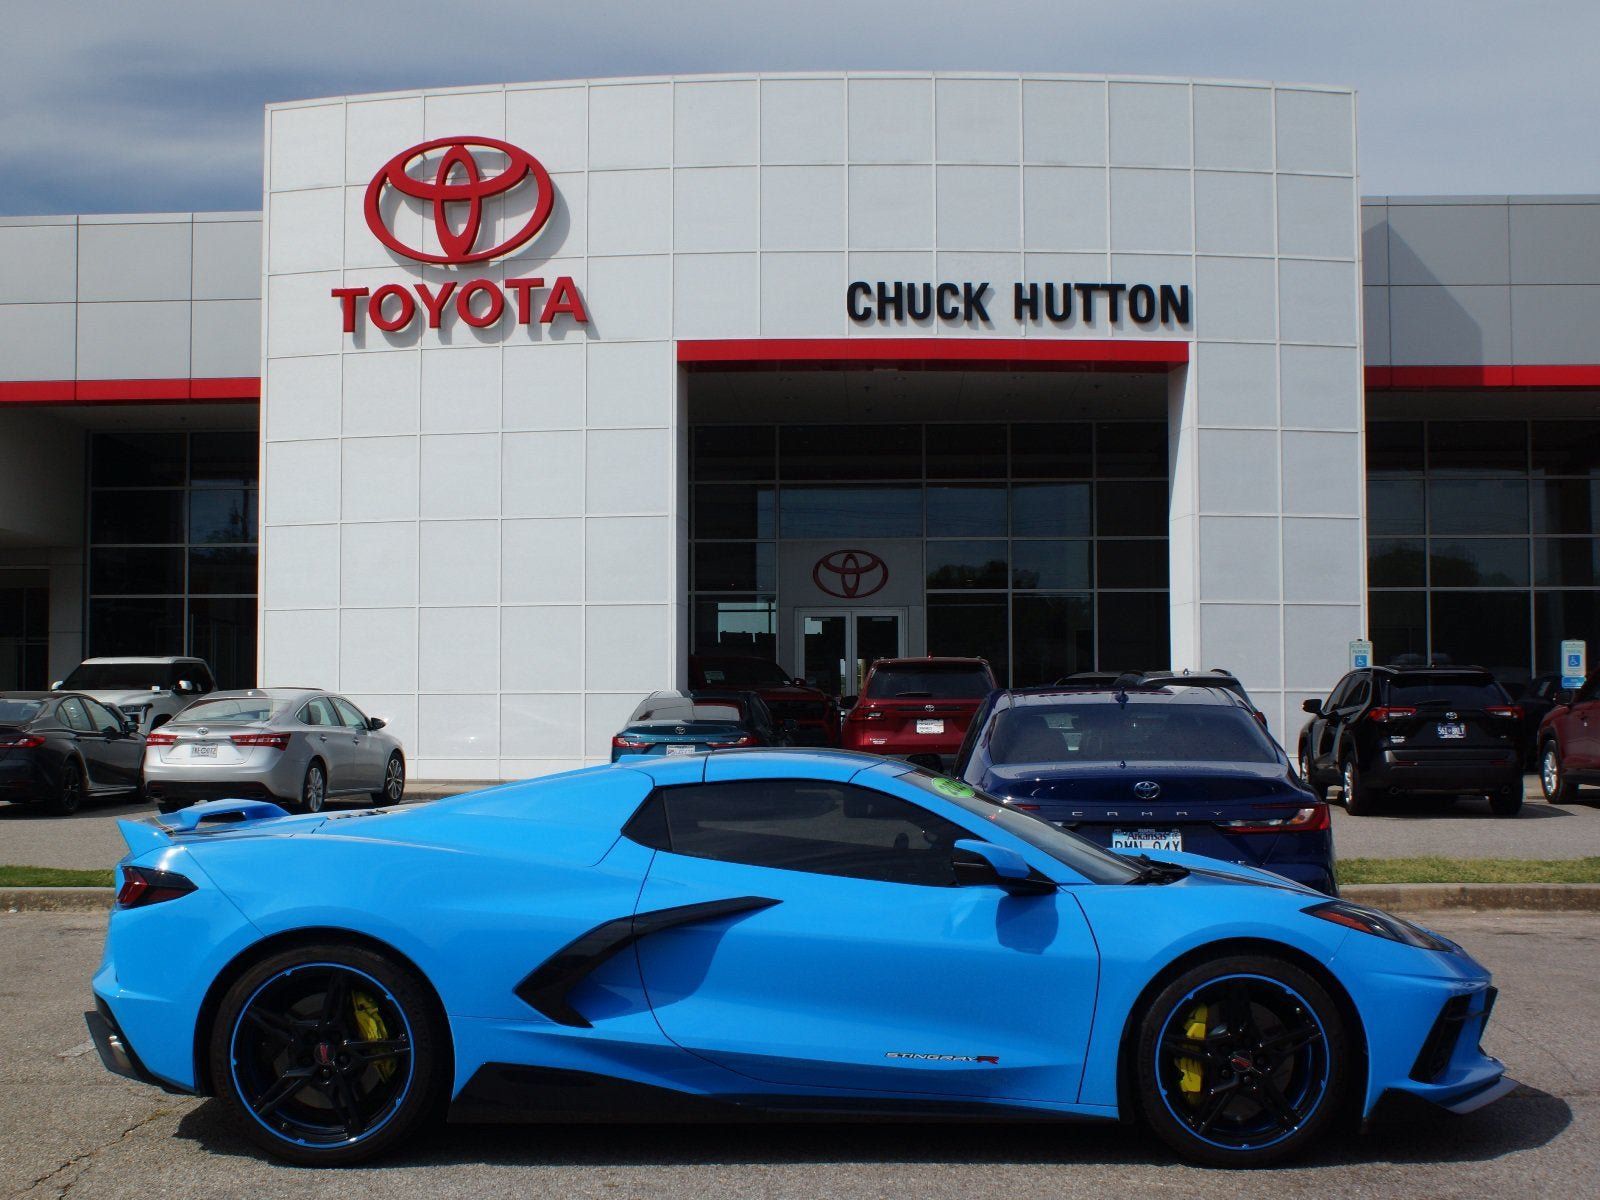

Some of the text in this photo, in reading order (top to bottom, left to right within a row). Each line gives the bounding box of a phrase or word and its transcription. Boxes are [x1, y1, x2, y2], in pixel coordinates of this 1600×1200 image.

[331, 276, 589, 333] TOYOTA
[847, 281, 1190, 324] CHUCK HUTTON
[1127, 831, 1168, 841] Arkansas
[885, 1051, 978, 1063] STINGRAY
